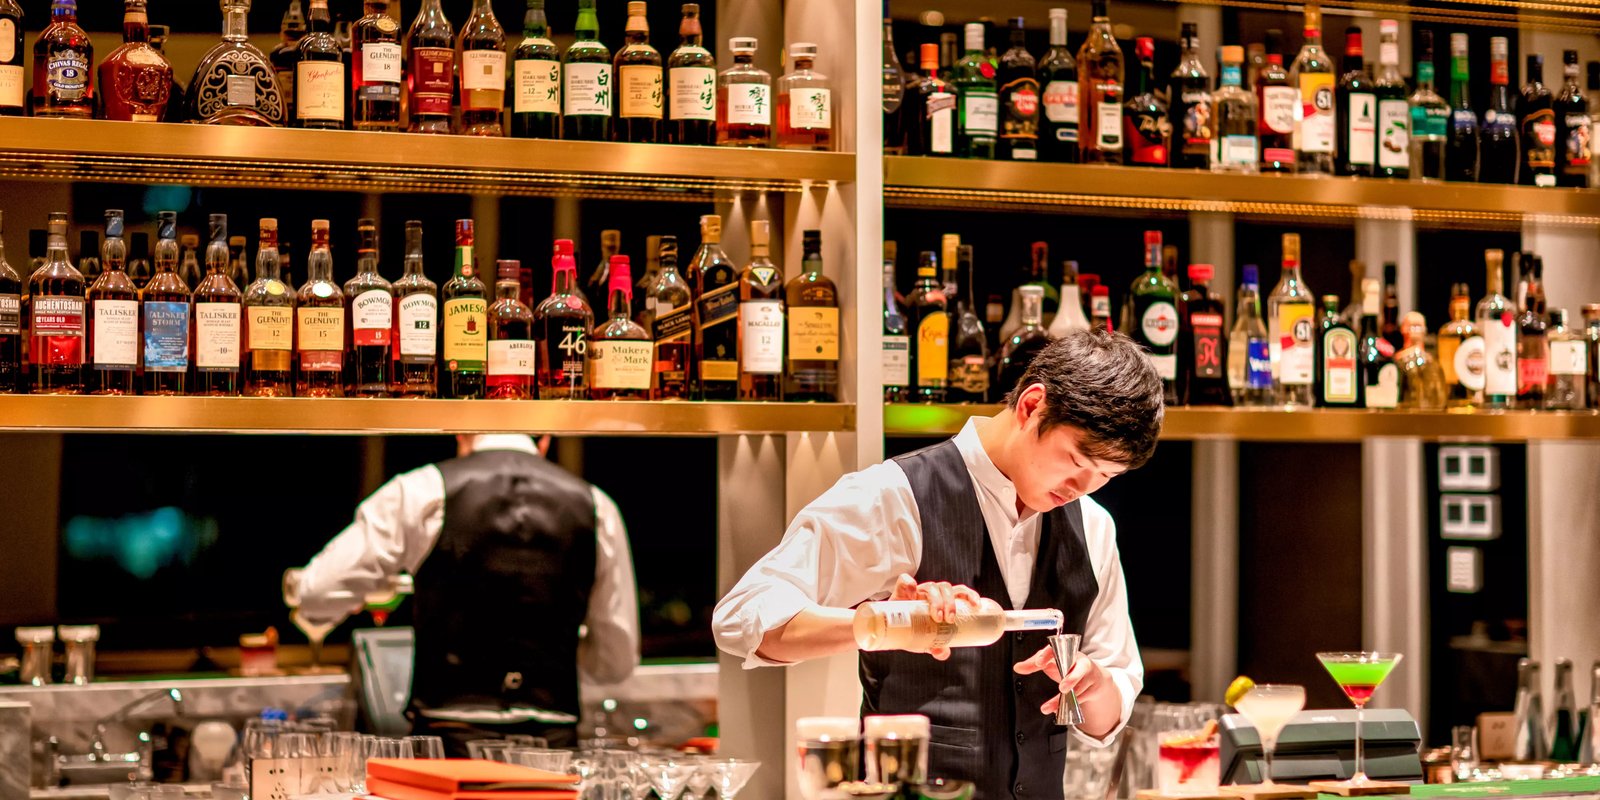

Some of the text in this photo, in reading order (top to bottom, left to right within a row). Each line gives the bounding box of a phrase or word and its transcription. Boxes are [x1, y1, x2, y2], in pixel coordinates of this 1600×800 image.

[48, 59, 88, 71] CHIVAS REGAL
[66, 69, 74, 77] 18
[547, 65, 559, 105] 白州
[595, 69, 609, 109] 白州
[35, 301, 82, 311] AUCHENTOSHAN
[357, 296, 391, 309] BOWMOR
[403, 300, 436, 310] BOWMOR
[149, 311, 185, 319] TALISKER
[449, 303, 486, 316] JAMESO
[657, 319, 675, 330] BLACK
[558, 332, 586, 357] 46
[761, 335, 771, 344] 12
[623, 355, 649, 364] Mark
